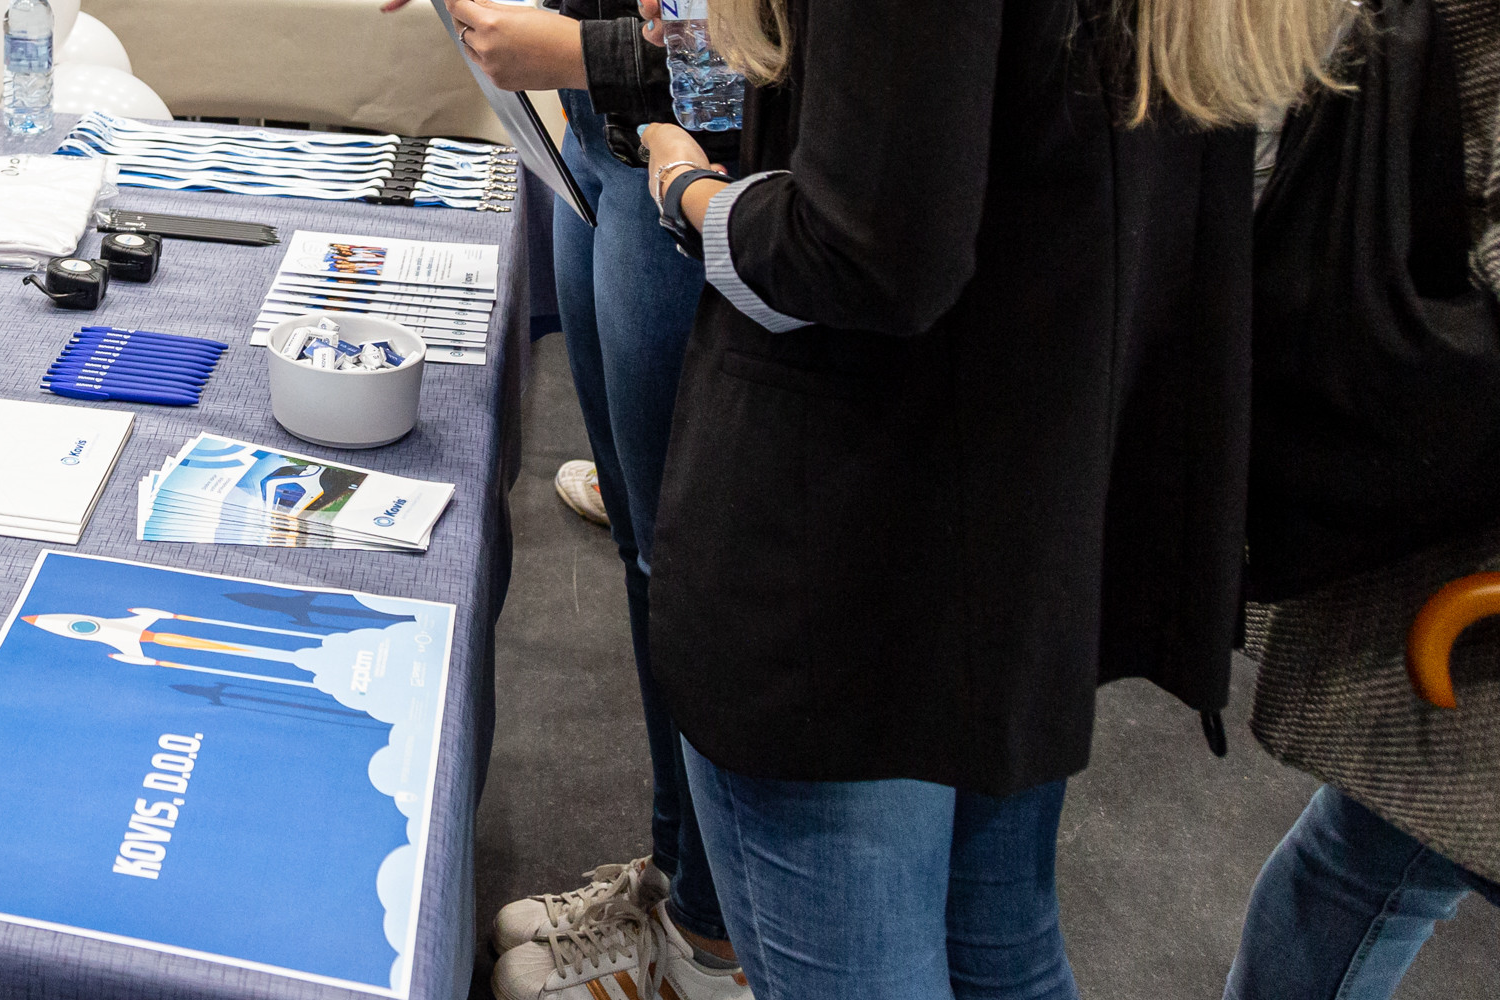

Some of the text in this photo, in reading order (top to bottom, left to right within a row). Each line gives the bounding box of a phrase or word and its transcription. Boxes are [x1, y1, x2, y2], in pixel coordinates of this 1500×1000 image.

[384, 498, 407, 517] Kovis
[112, 732, 204, 880] KOVIS, D.O.O.
